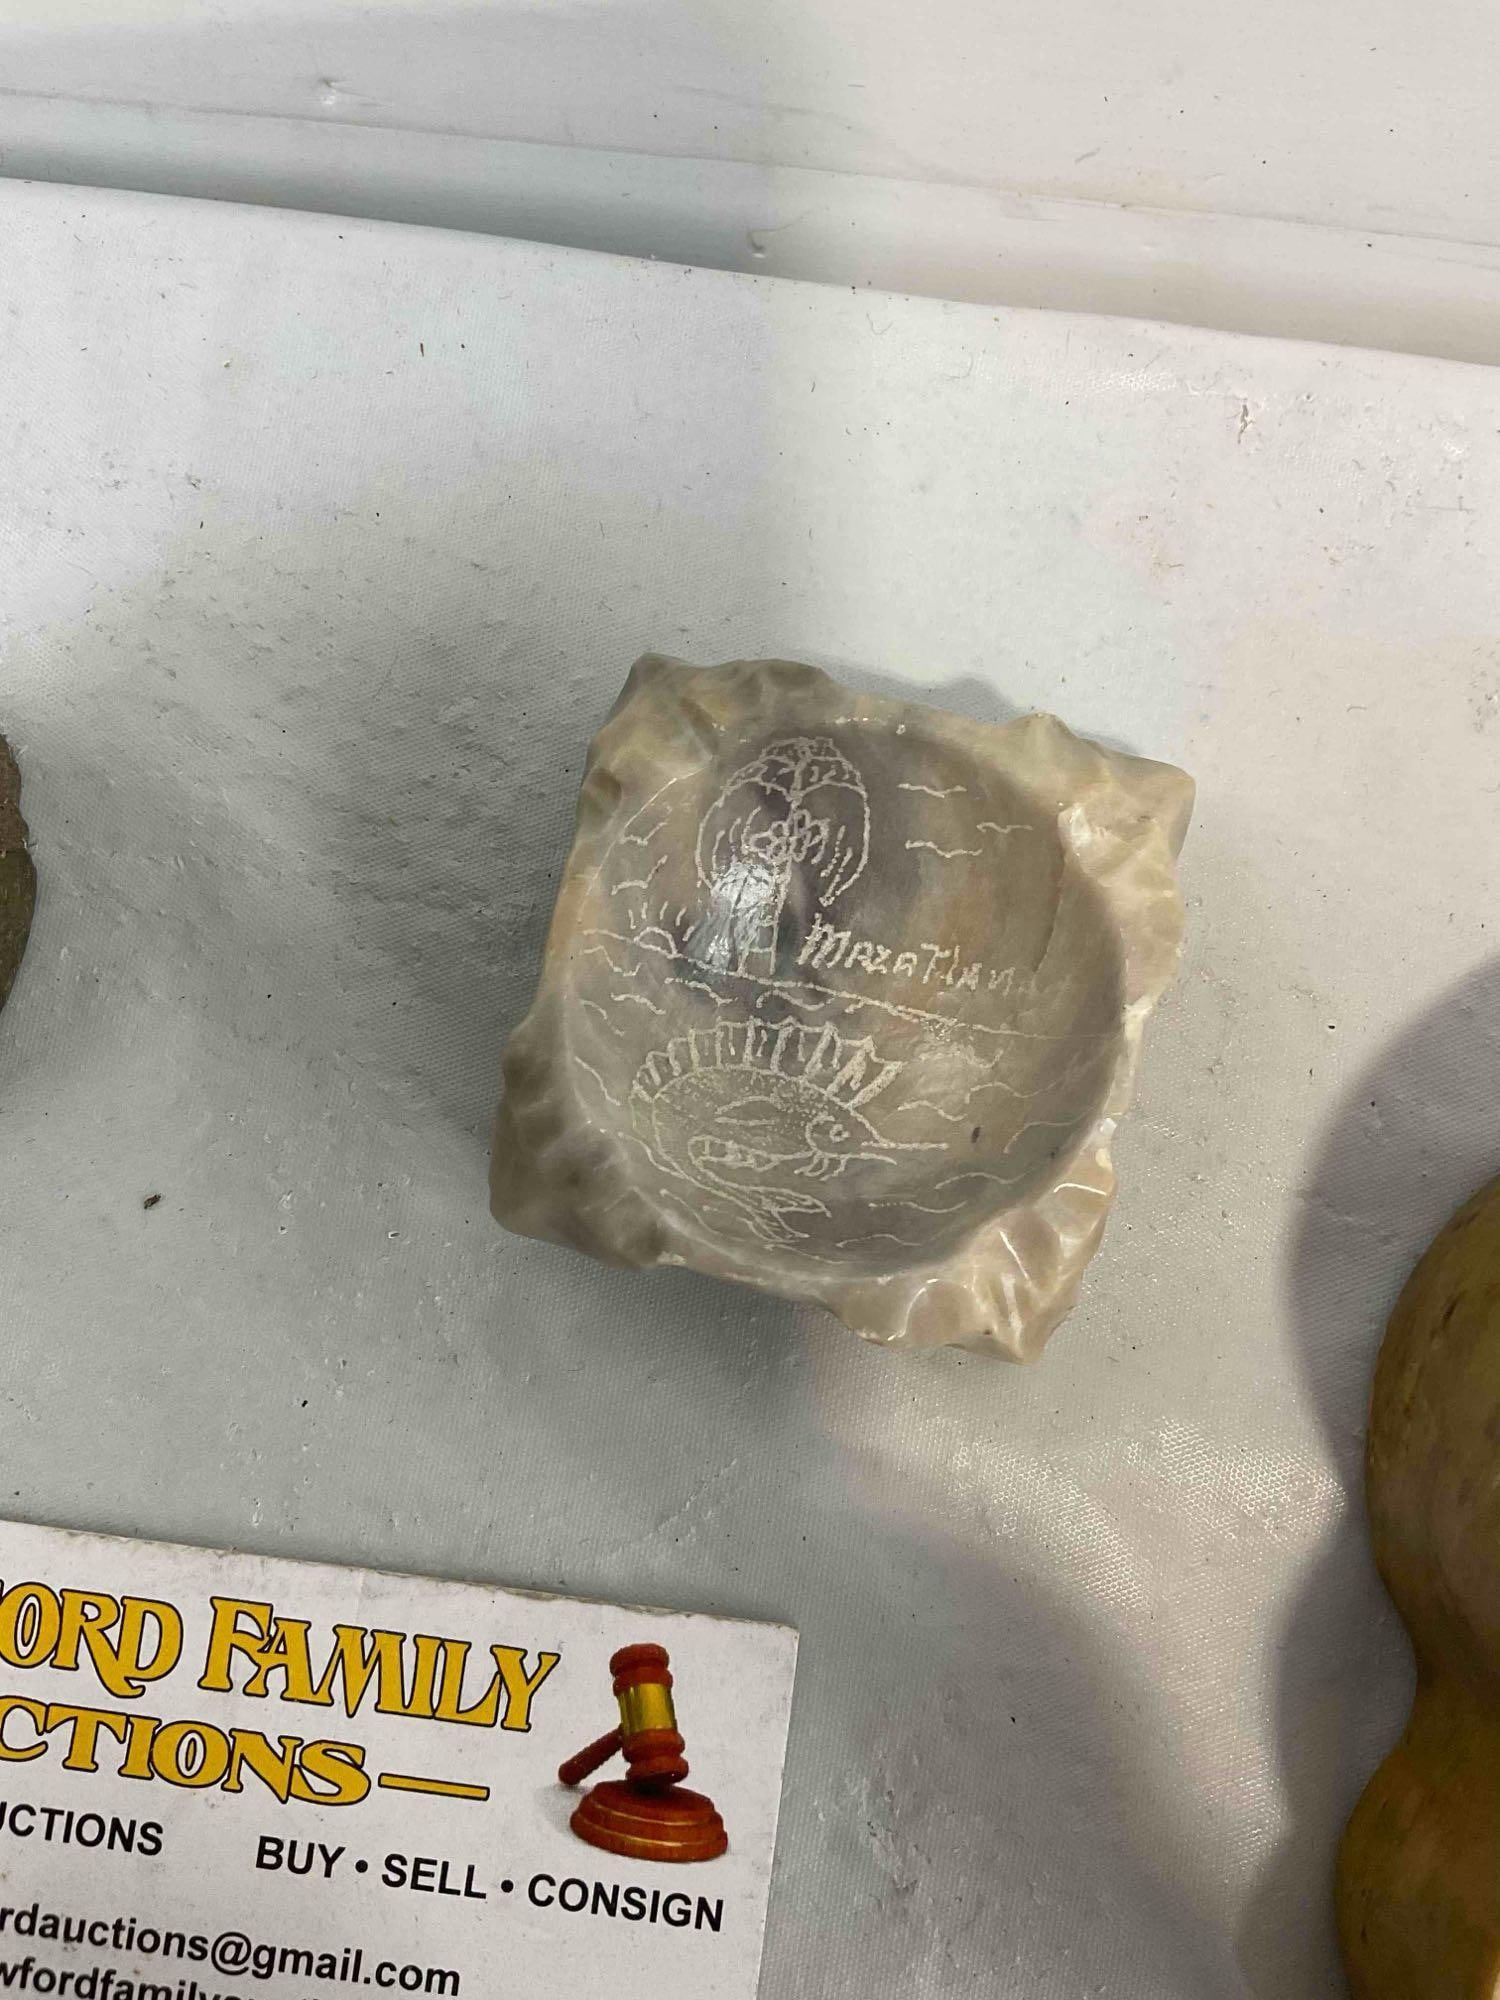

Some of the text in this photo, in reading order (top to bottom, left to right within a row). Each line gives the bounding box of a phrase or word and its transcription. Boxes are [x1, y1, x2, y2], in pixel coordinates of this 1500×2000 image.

[0, 1580, 560, 1732] ORD FAMILY
[255, 1835, 346, 1879] BUY
[381, 1853, 487, 1899] SELL
[527, 1873, 724, 1932] CONSIGN
